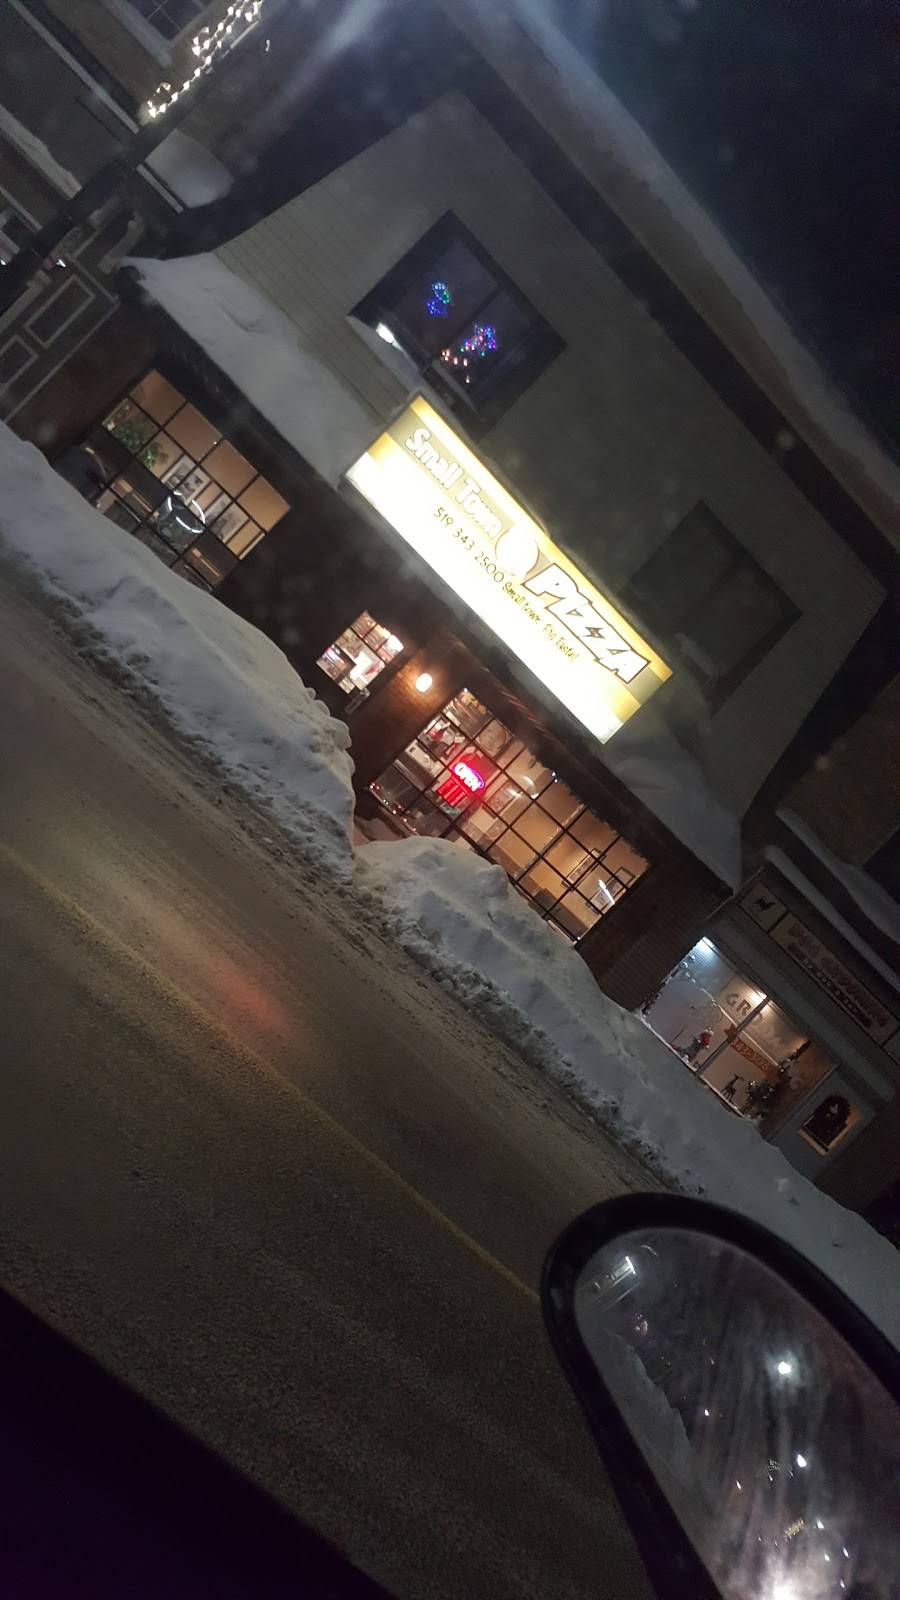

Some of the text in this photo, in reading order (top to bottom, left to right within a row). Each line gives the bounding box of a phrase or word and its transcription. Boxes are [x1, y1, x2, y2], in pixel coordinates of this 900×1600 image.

[405, 428, 652, 685] Small Town PIZZA
[433, 507, 505, 584] 519 343 2500
[453, 762, 483, 793] OPEN
